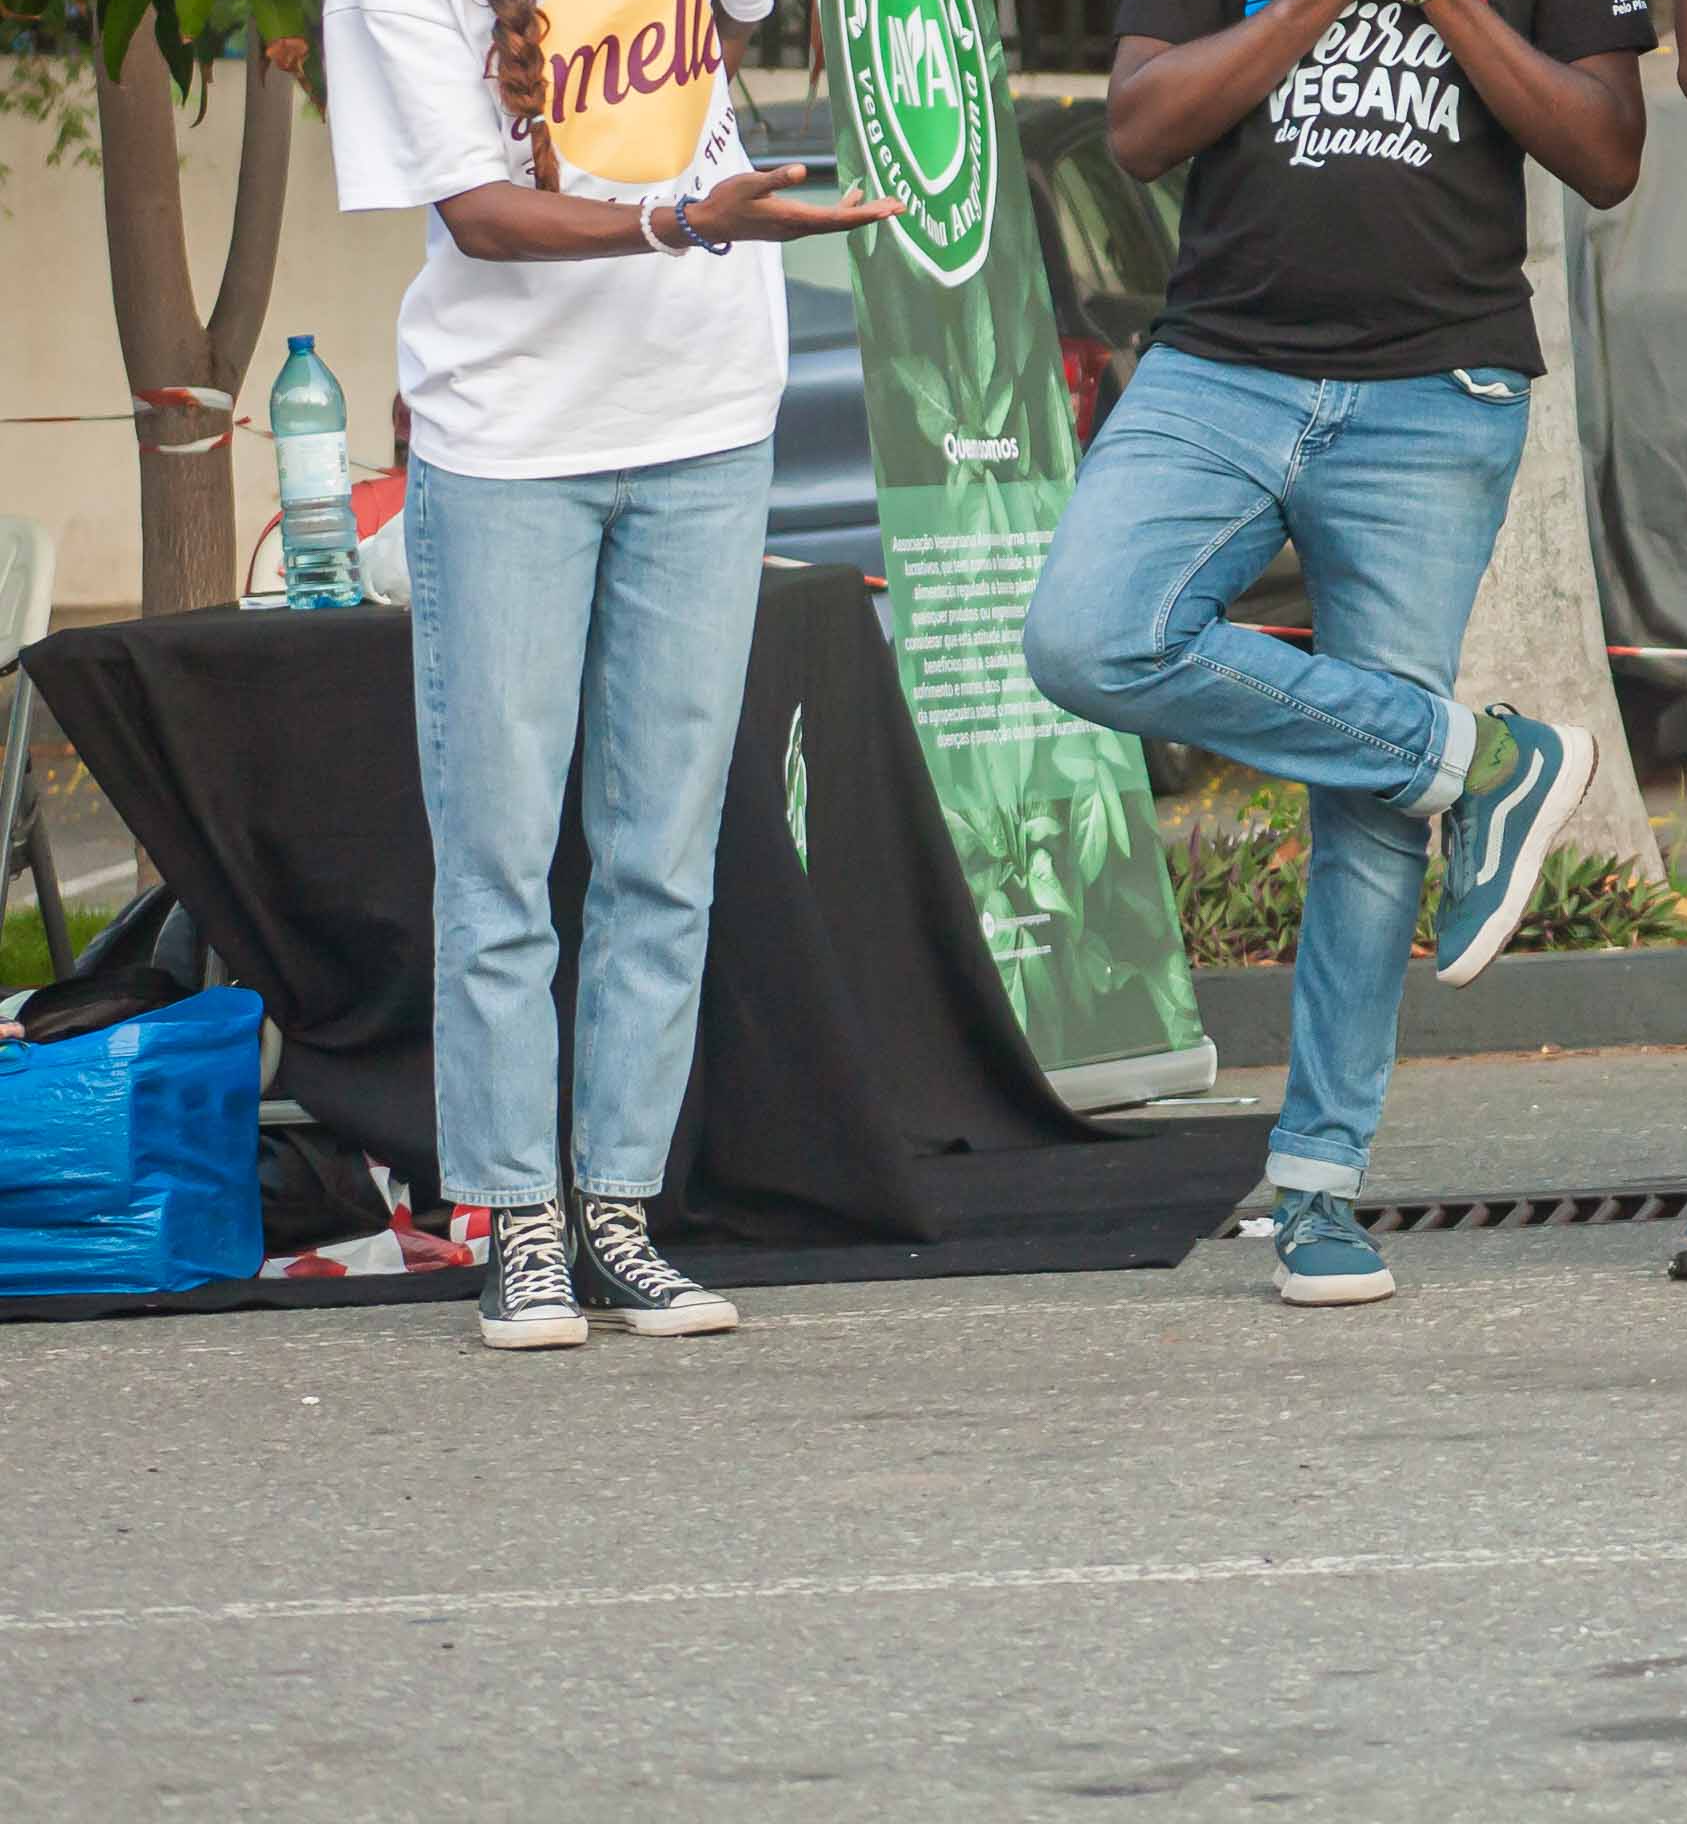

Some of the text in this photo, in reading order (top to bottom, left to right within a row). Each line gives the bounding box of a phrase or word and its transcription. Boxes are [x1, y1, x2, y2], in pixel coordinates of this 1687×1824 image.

[888, 5, 958, 109] AVA
[1313, 0, 1452, 69] eira
[1269, 62, 1460, 143] VEGANA
[1274, 116, 1432, 168] de Luanda
[858, 67, 948, 247] Vegetariana
